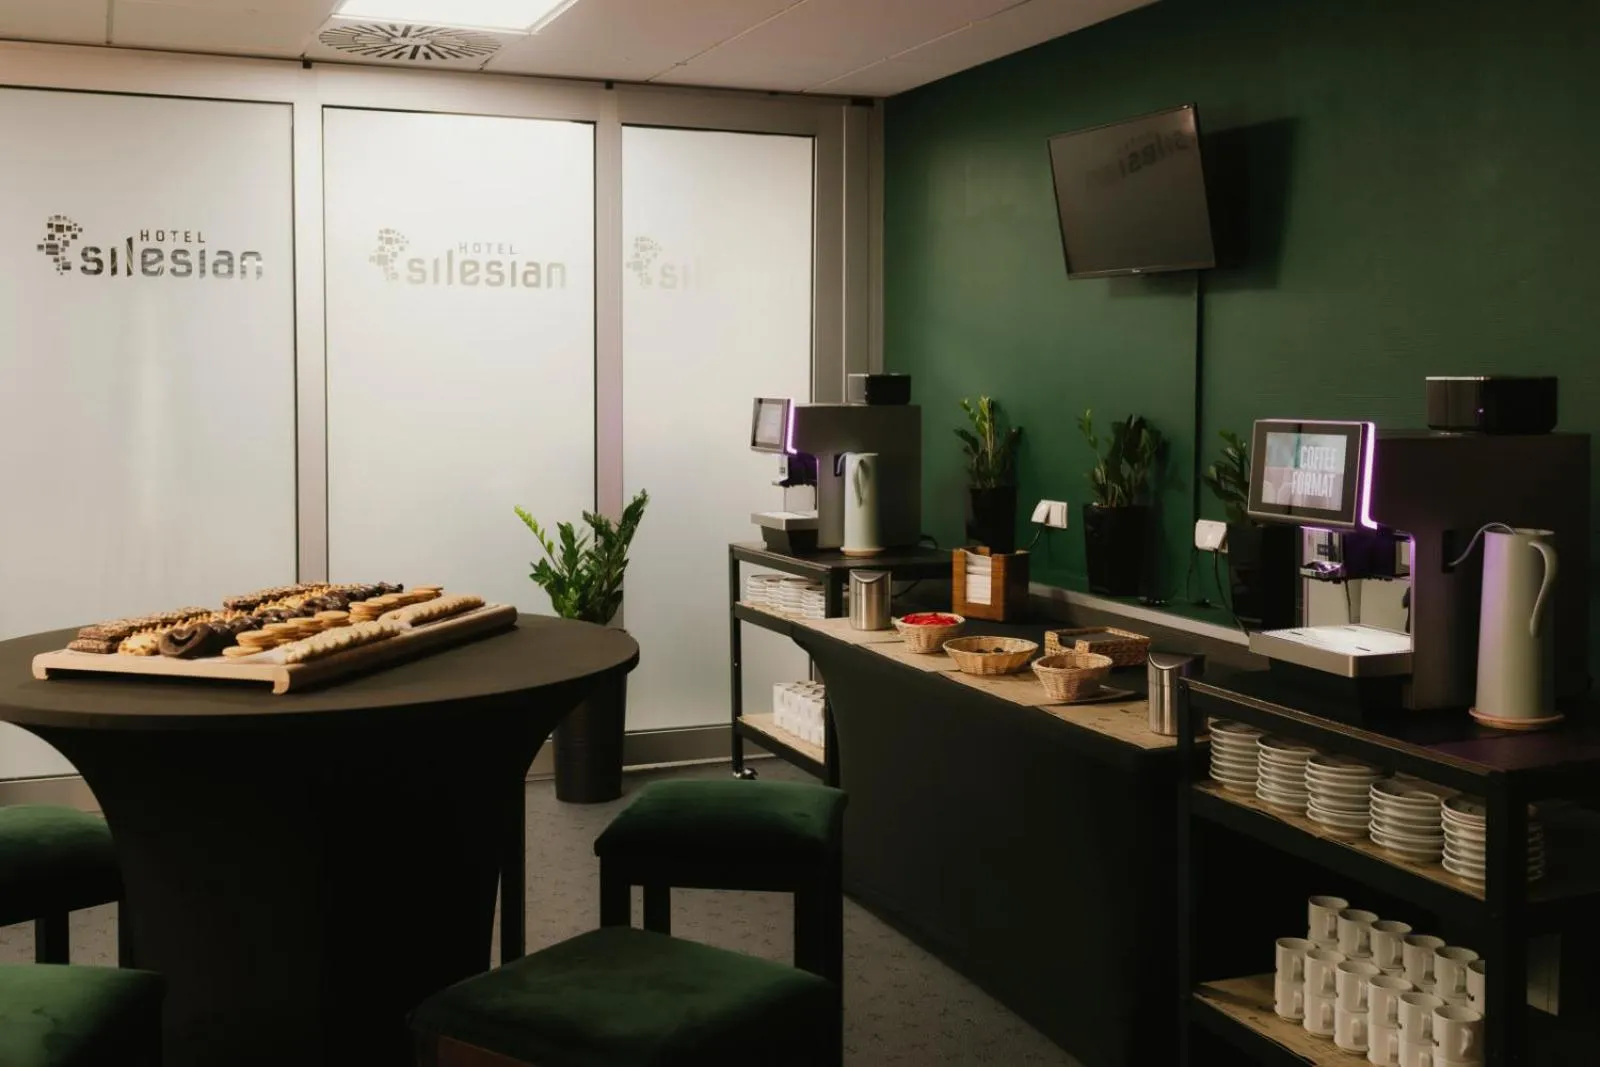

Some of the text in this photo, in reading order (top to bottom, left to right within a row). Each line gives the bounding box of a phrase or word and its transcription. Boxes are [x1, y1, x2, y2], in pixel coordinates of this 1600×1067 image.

[140, 229, 206, 243] HOTEL
[458, 242, 520, 255] HOTEL
[80, 237, 263, 280] silesian
[406, 249, 566, 289] silesian
[1300, 446, 1338, 470] COFFEE
[1291, 471, 1336, 497] FORMAT
